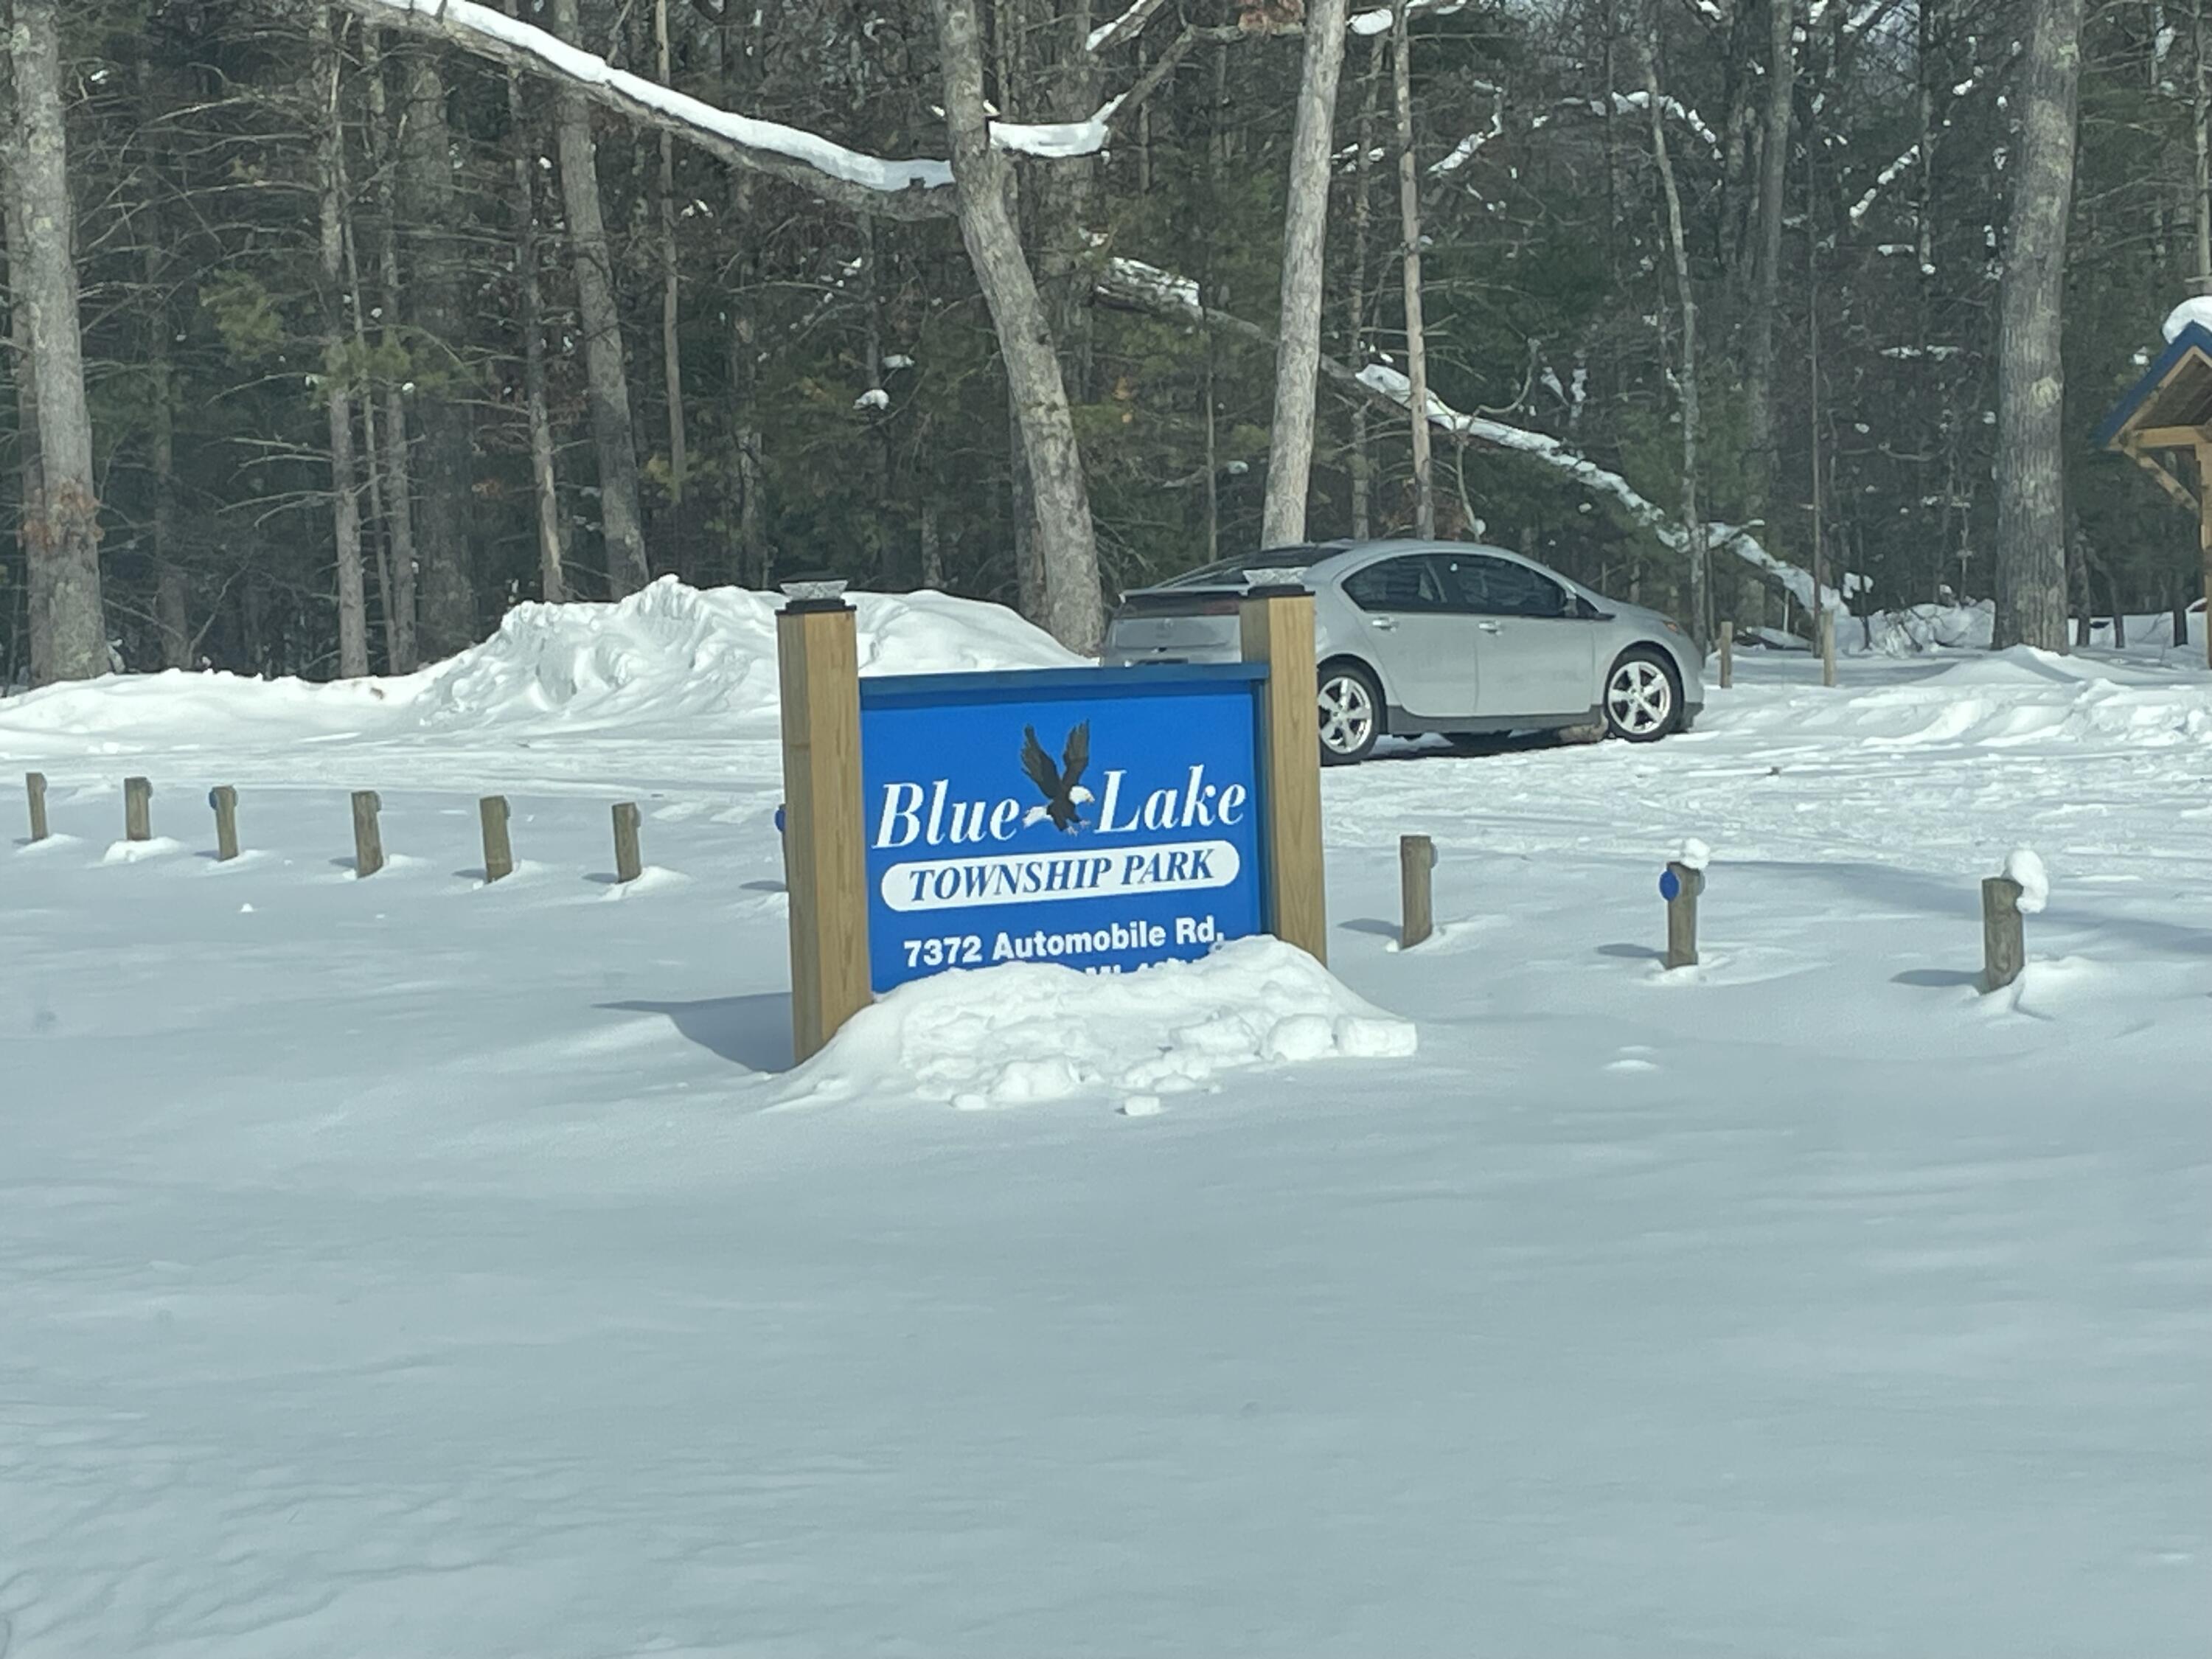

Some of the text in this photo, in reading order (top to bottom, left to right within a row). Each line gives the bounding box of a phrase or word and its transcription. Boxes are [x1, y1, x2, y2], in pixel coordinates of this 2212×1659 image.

[871, 765, 1247, 849] Blue Lake
[910, 849, 1214, 901] TOWNSHIP PARK
[904, 916, 1224, 968] 7372 Automobile Rd.
